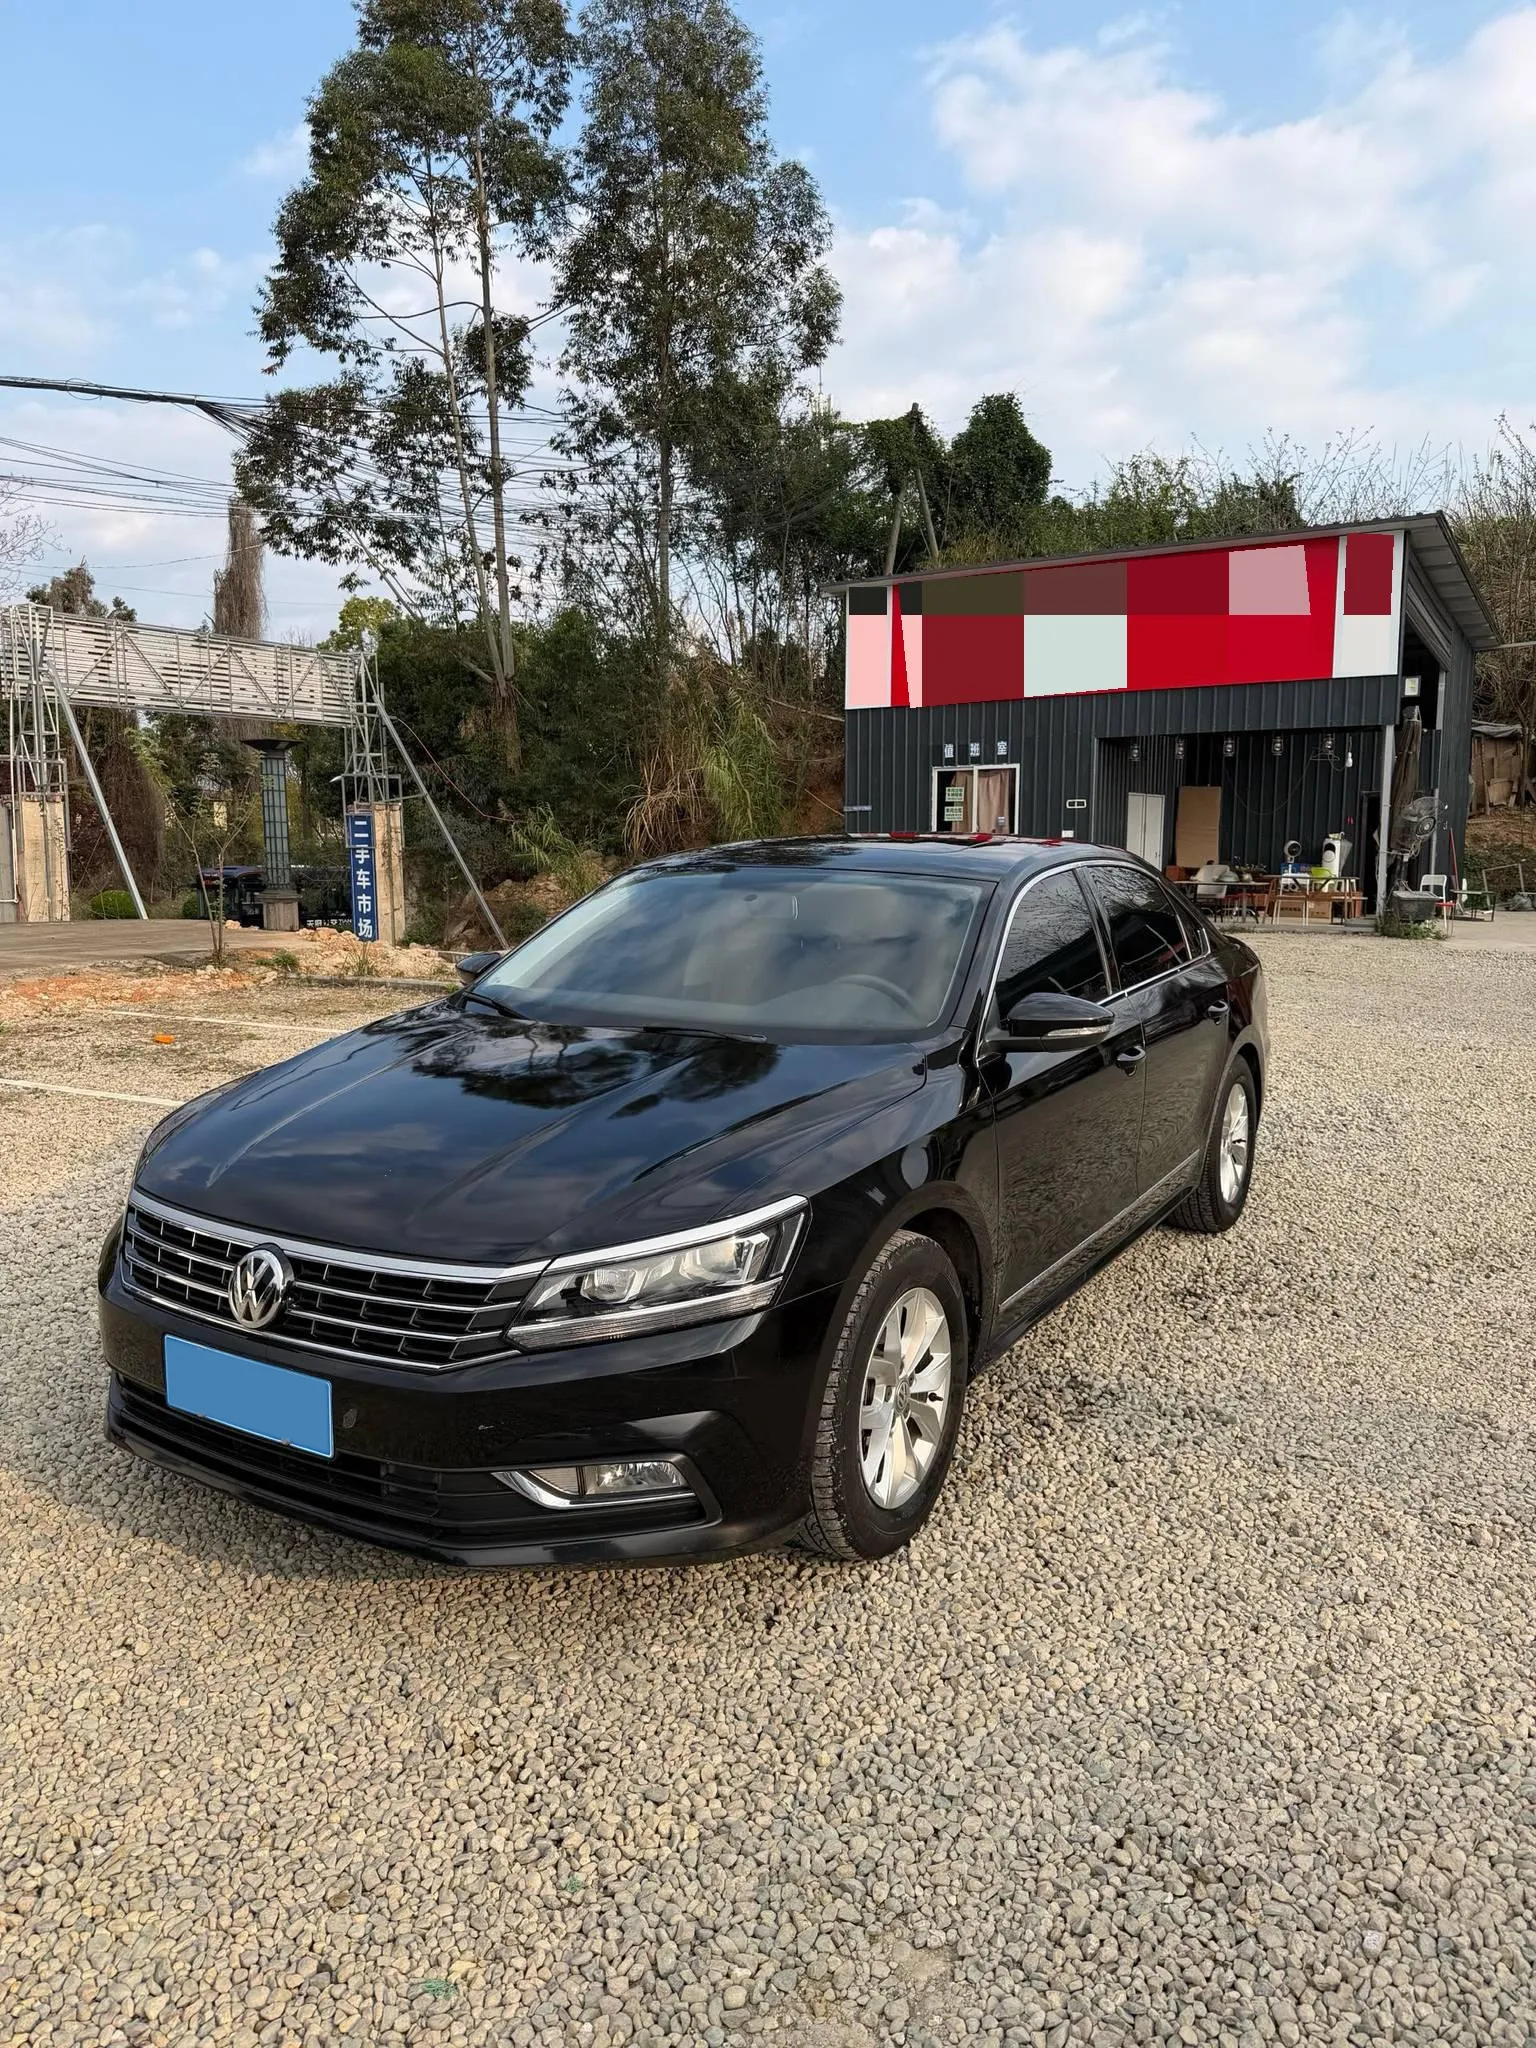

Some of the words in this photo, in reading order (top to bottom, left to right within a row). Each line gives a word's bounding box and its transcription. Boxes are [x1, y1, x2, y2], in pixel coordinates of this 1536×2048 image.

[944, 741, 1007, 758] 值班室
[354, 820, 373, 938] 二手车市场
